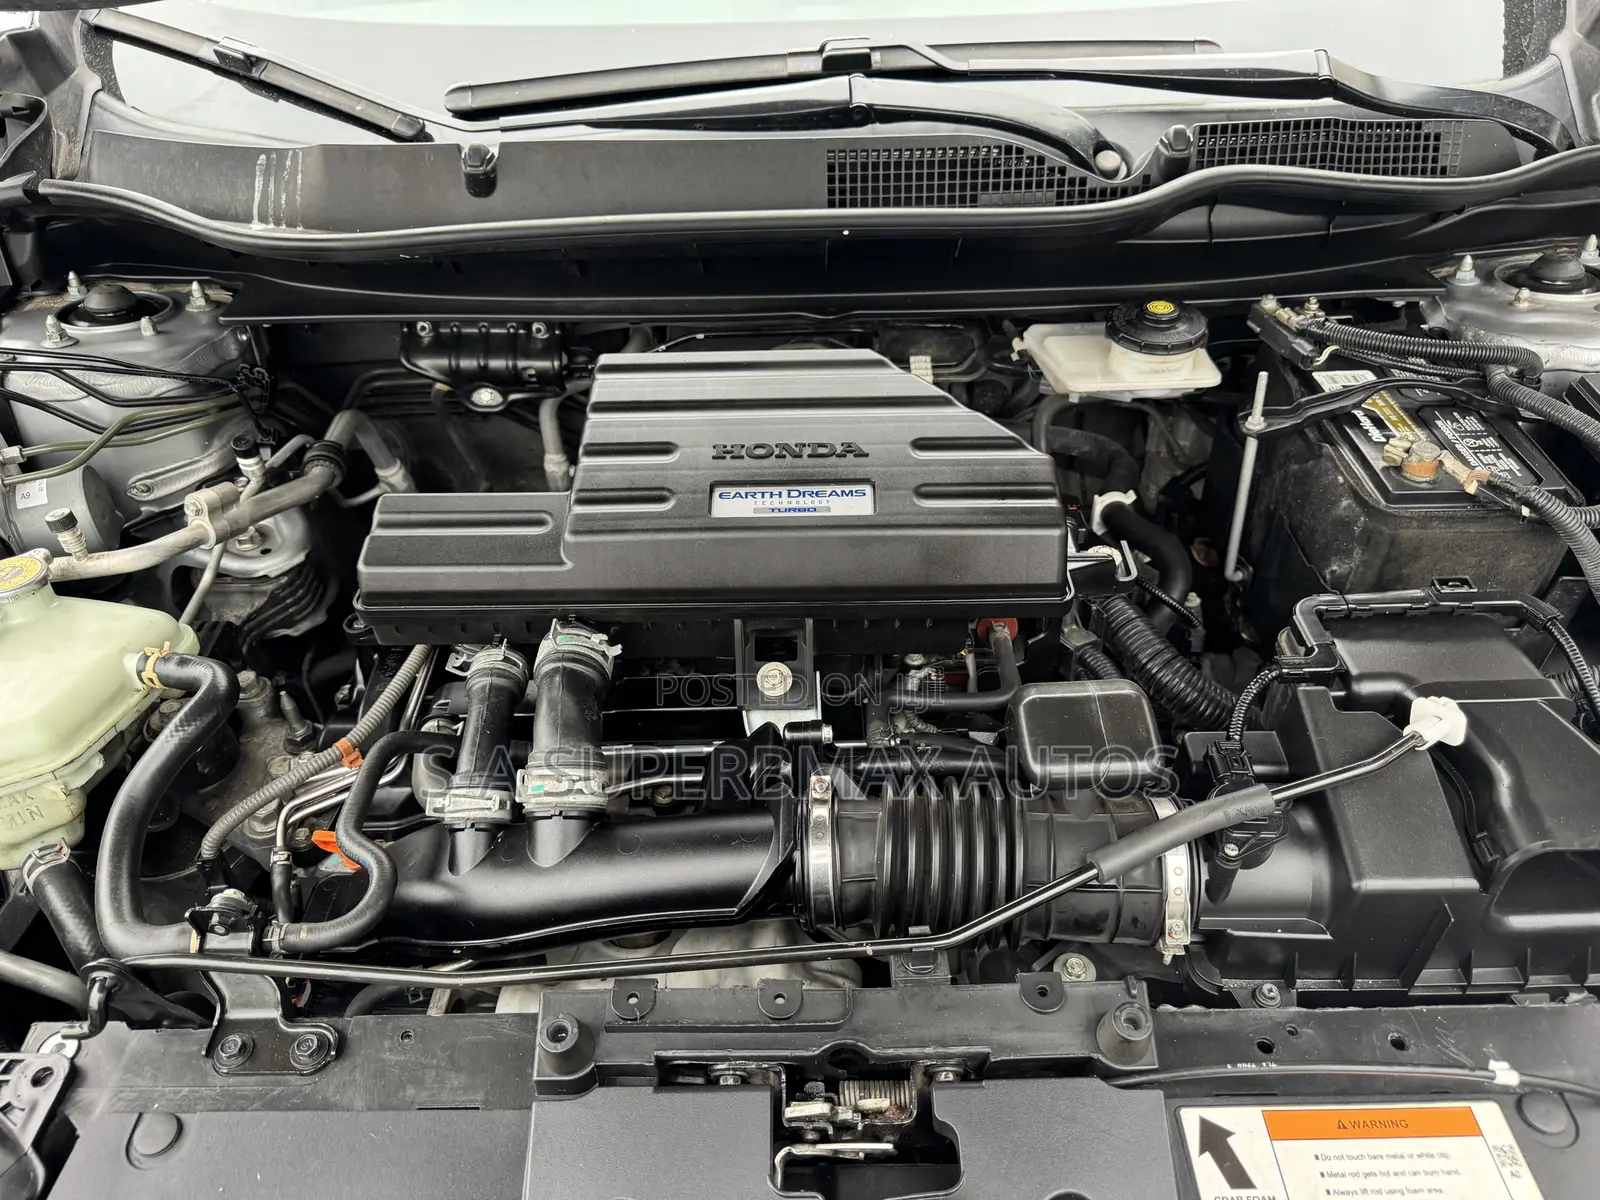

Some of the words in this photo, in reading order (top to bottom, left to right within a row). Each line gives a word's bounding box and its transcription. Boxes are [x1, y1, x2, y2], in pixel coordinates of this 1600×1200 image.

[711, 442, 870, 460] HONDA
[20, 491, 31, 501] A9
[718, 491, 783, 500] EARTH
[787, 489, 867, 499] DREAMS
[1349, 1119, 1409, 1130] WARNING
[1320, 1153, 1332, 1162] Do
[1333, 1153, 1346, 1161] not
[1347, 1153, 1366, 1161] touch
[1367, 1152, 1385, 1161] bare
[1385, 1151, 1406, 1160] metal
[1416, 1151, 1436, 1159] white
[1326, 1170, 1347, 1178] Metal
[1348, 1170, 1361, 1178] rod
[1362, 1171, 1378, 1180] gets
[1379, 1170, 1391, 1178] hot
[1393, 1170, 1406, 1178] and
[1332, 1188, 1359, 1197] Always
[1371, 1188, 1383, 1196] rod
[1385, 1188, 1405, 1198] using
[1406, 1187, 1425, 1195] foam
